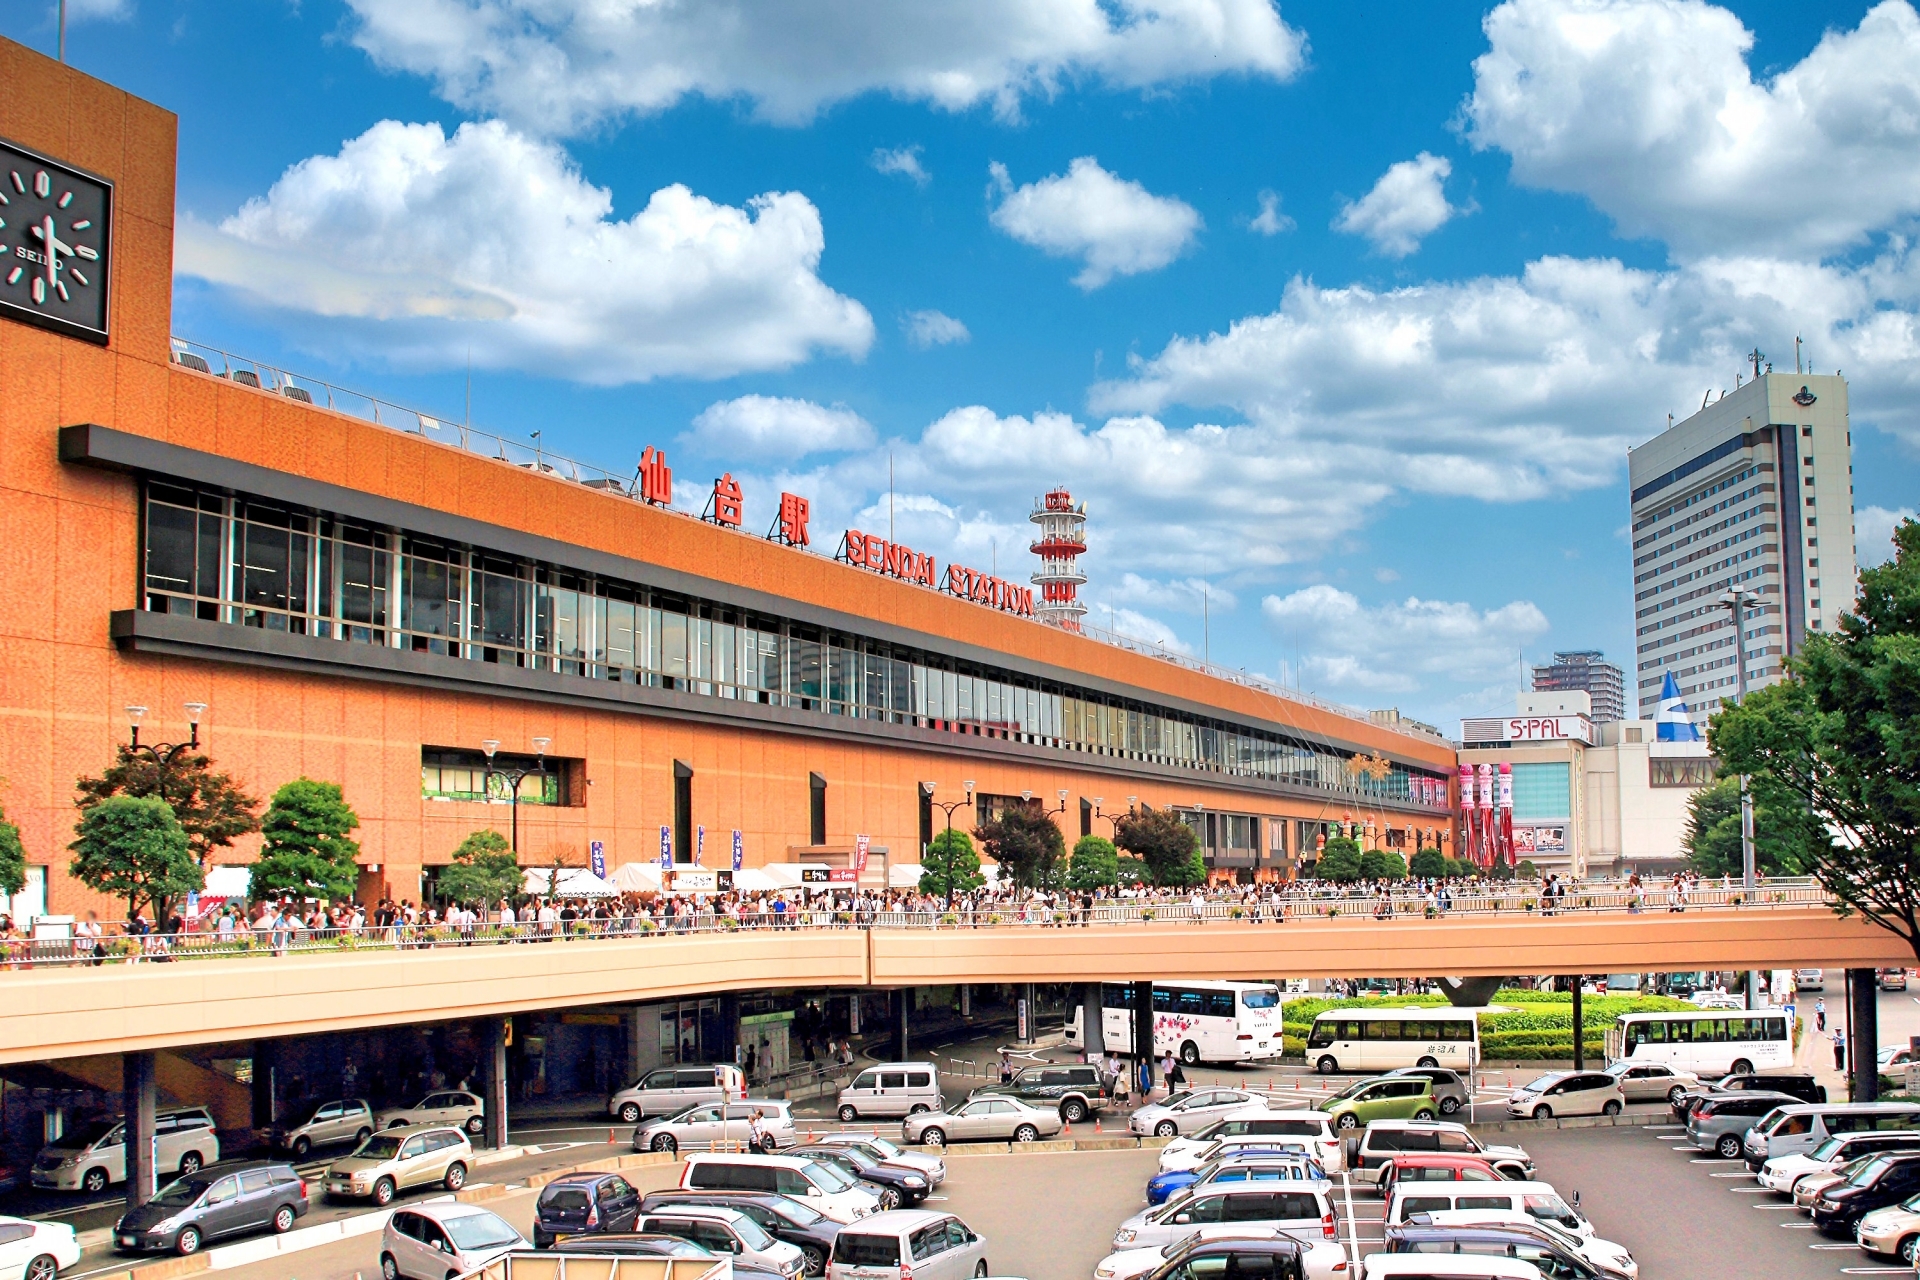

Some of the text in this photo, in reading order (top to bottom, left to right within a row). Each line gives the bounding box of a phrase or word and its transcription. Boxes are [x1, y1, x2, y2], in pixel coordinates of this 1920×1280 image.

[638, 445, 810, 546] 仙台駅
[847, 529, 1034, 616] SENDAI STATION
[1510, 719, 1569, 739] S-PAL
